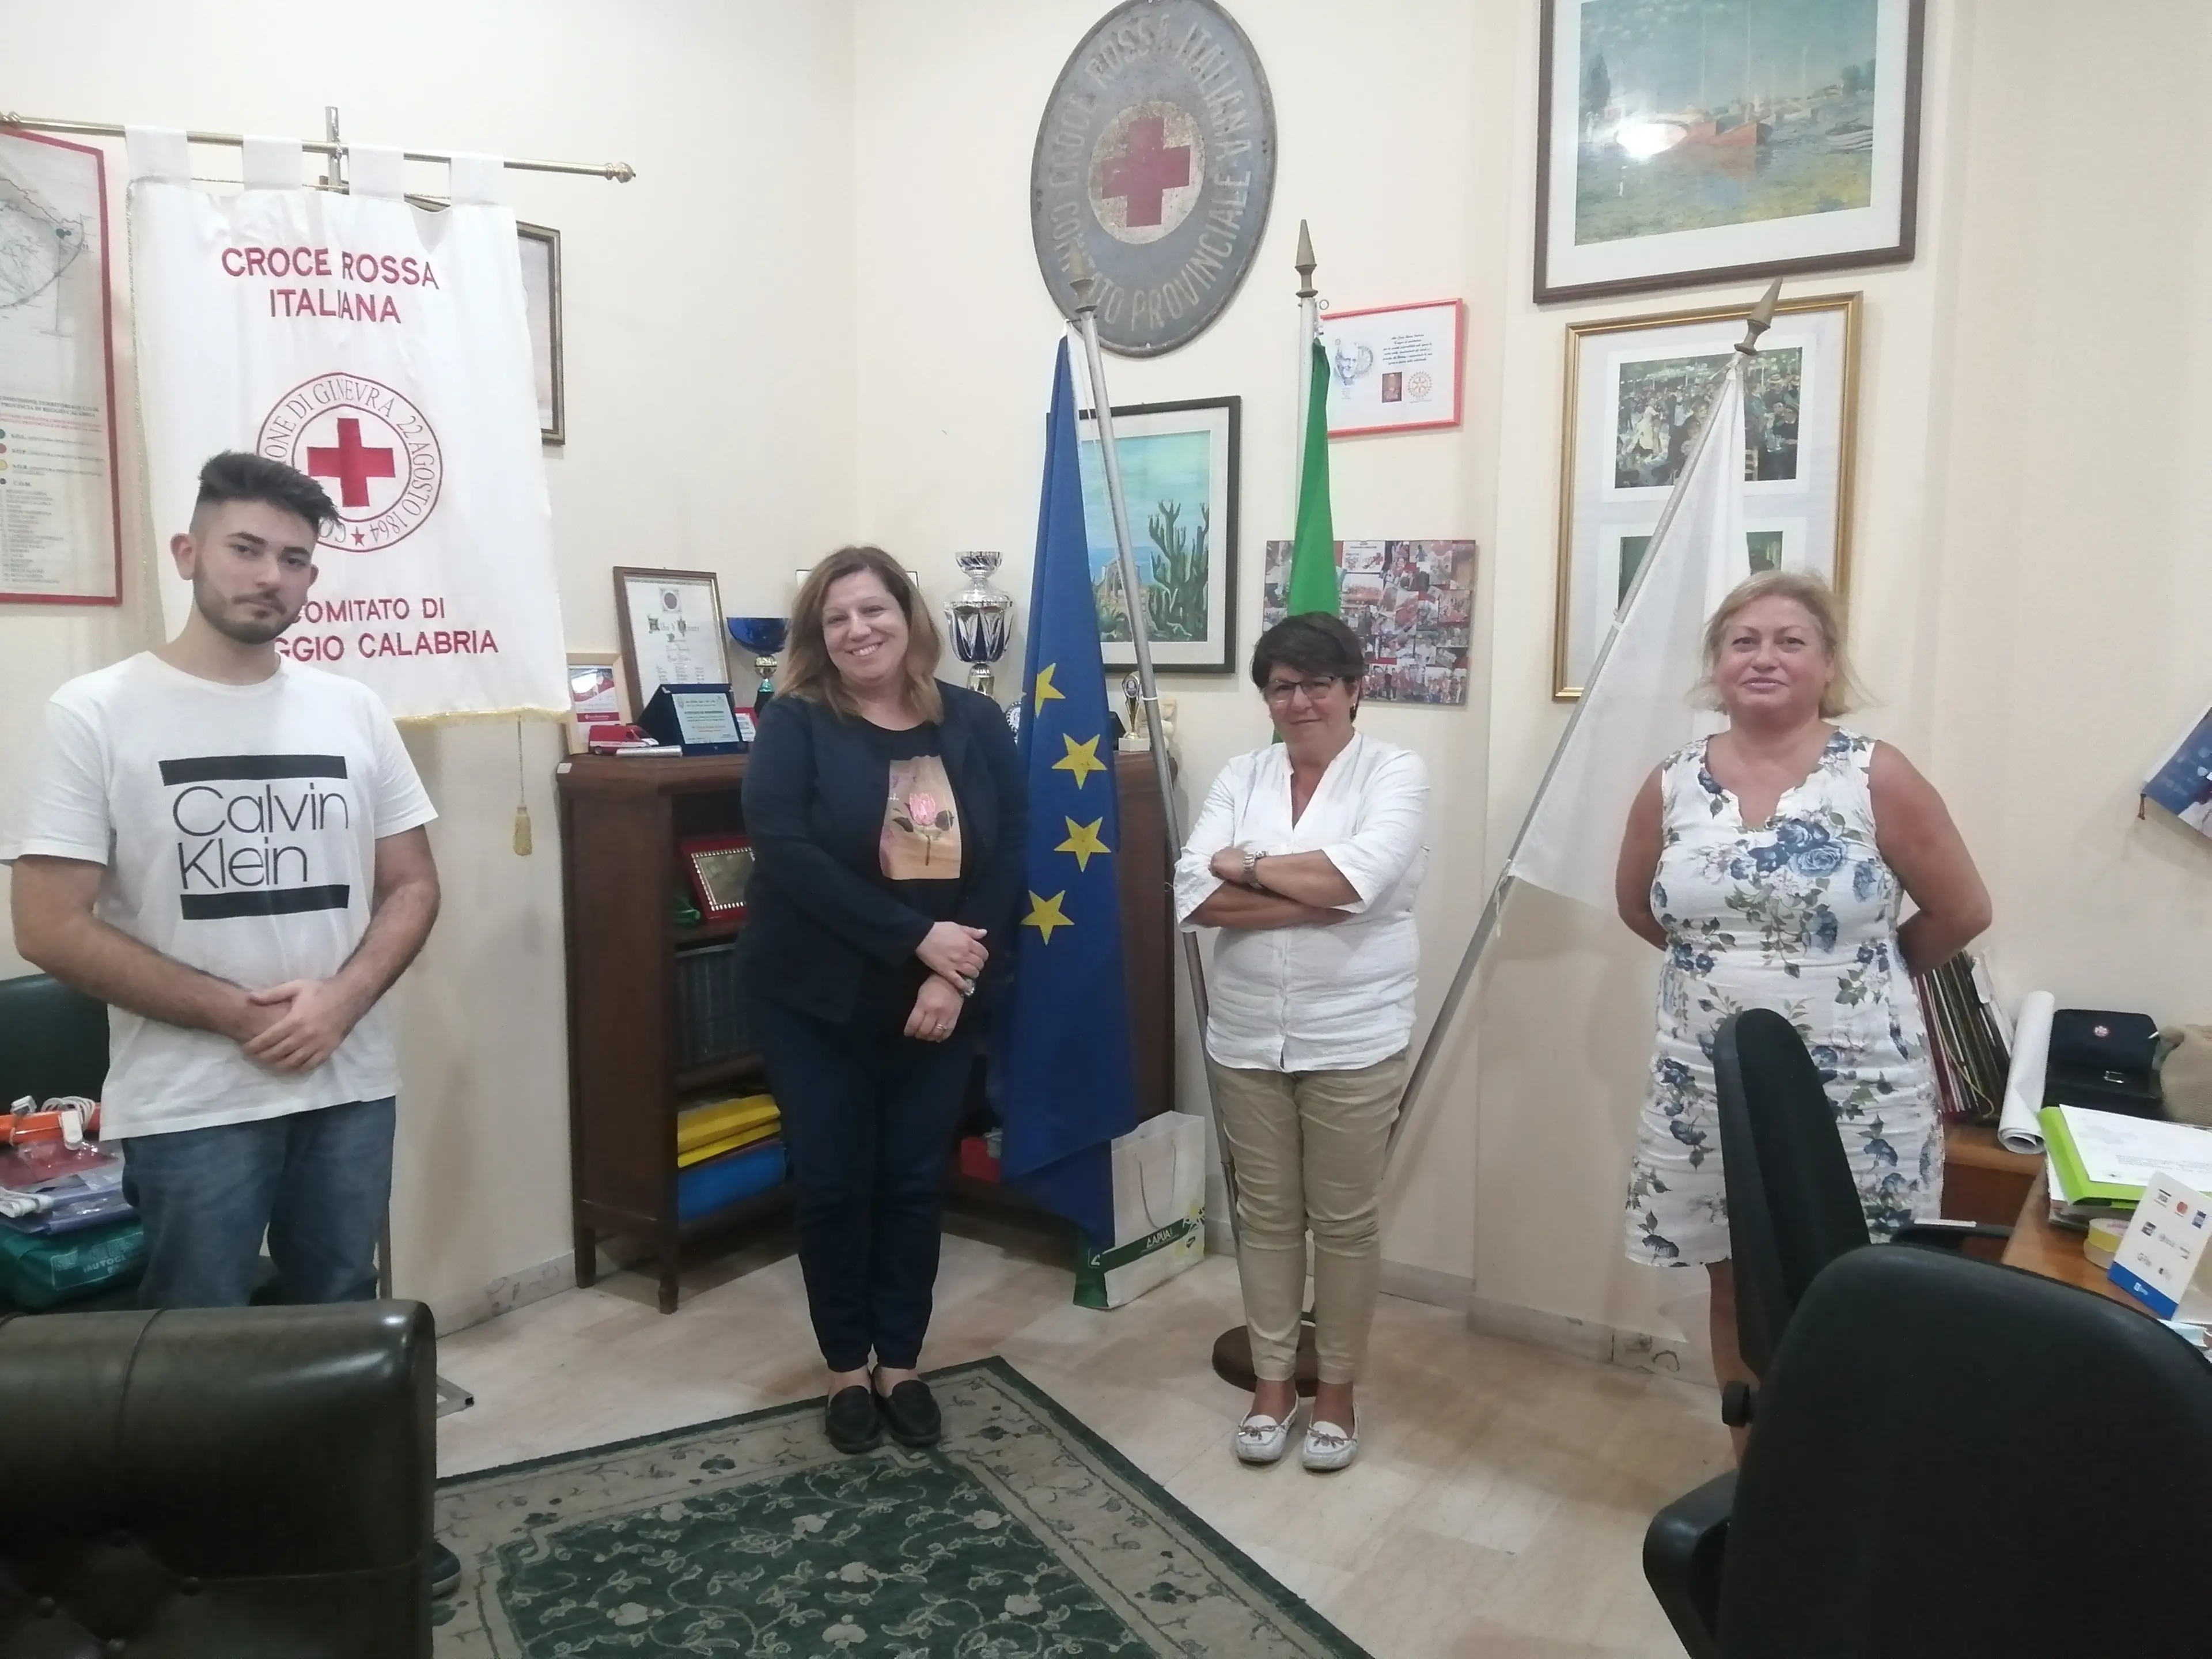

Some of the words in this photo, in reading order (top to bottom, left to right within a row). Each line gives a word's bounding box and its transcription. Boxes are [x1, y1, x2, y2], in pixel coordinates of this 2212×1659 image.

[222, 246, 332, 277] CROCE
[342, 251, 440, 290] ROSSA
[1131, 171, 1251, 332] PROVINCIALE
[270, 288, 402, 324] ITALIANA
[286, 393, 315, 419] DI
[313, 378, 395, 418] GINEVRA
[396, 415, 423, 438] 22
[402, 441, 435, 516] AGOSTO
[369, 510, 408, 543] 1864
[300, 597, 410, 623] OMITATO
[422, 597, 445, 619] DI
[274, 635, 345, 662] GGIO
[358, 630, 499, 658] CALABRIA
[173, 782, 349, 837] Calvin
[178, 836, 308, 890] Klein
